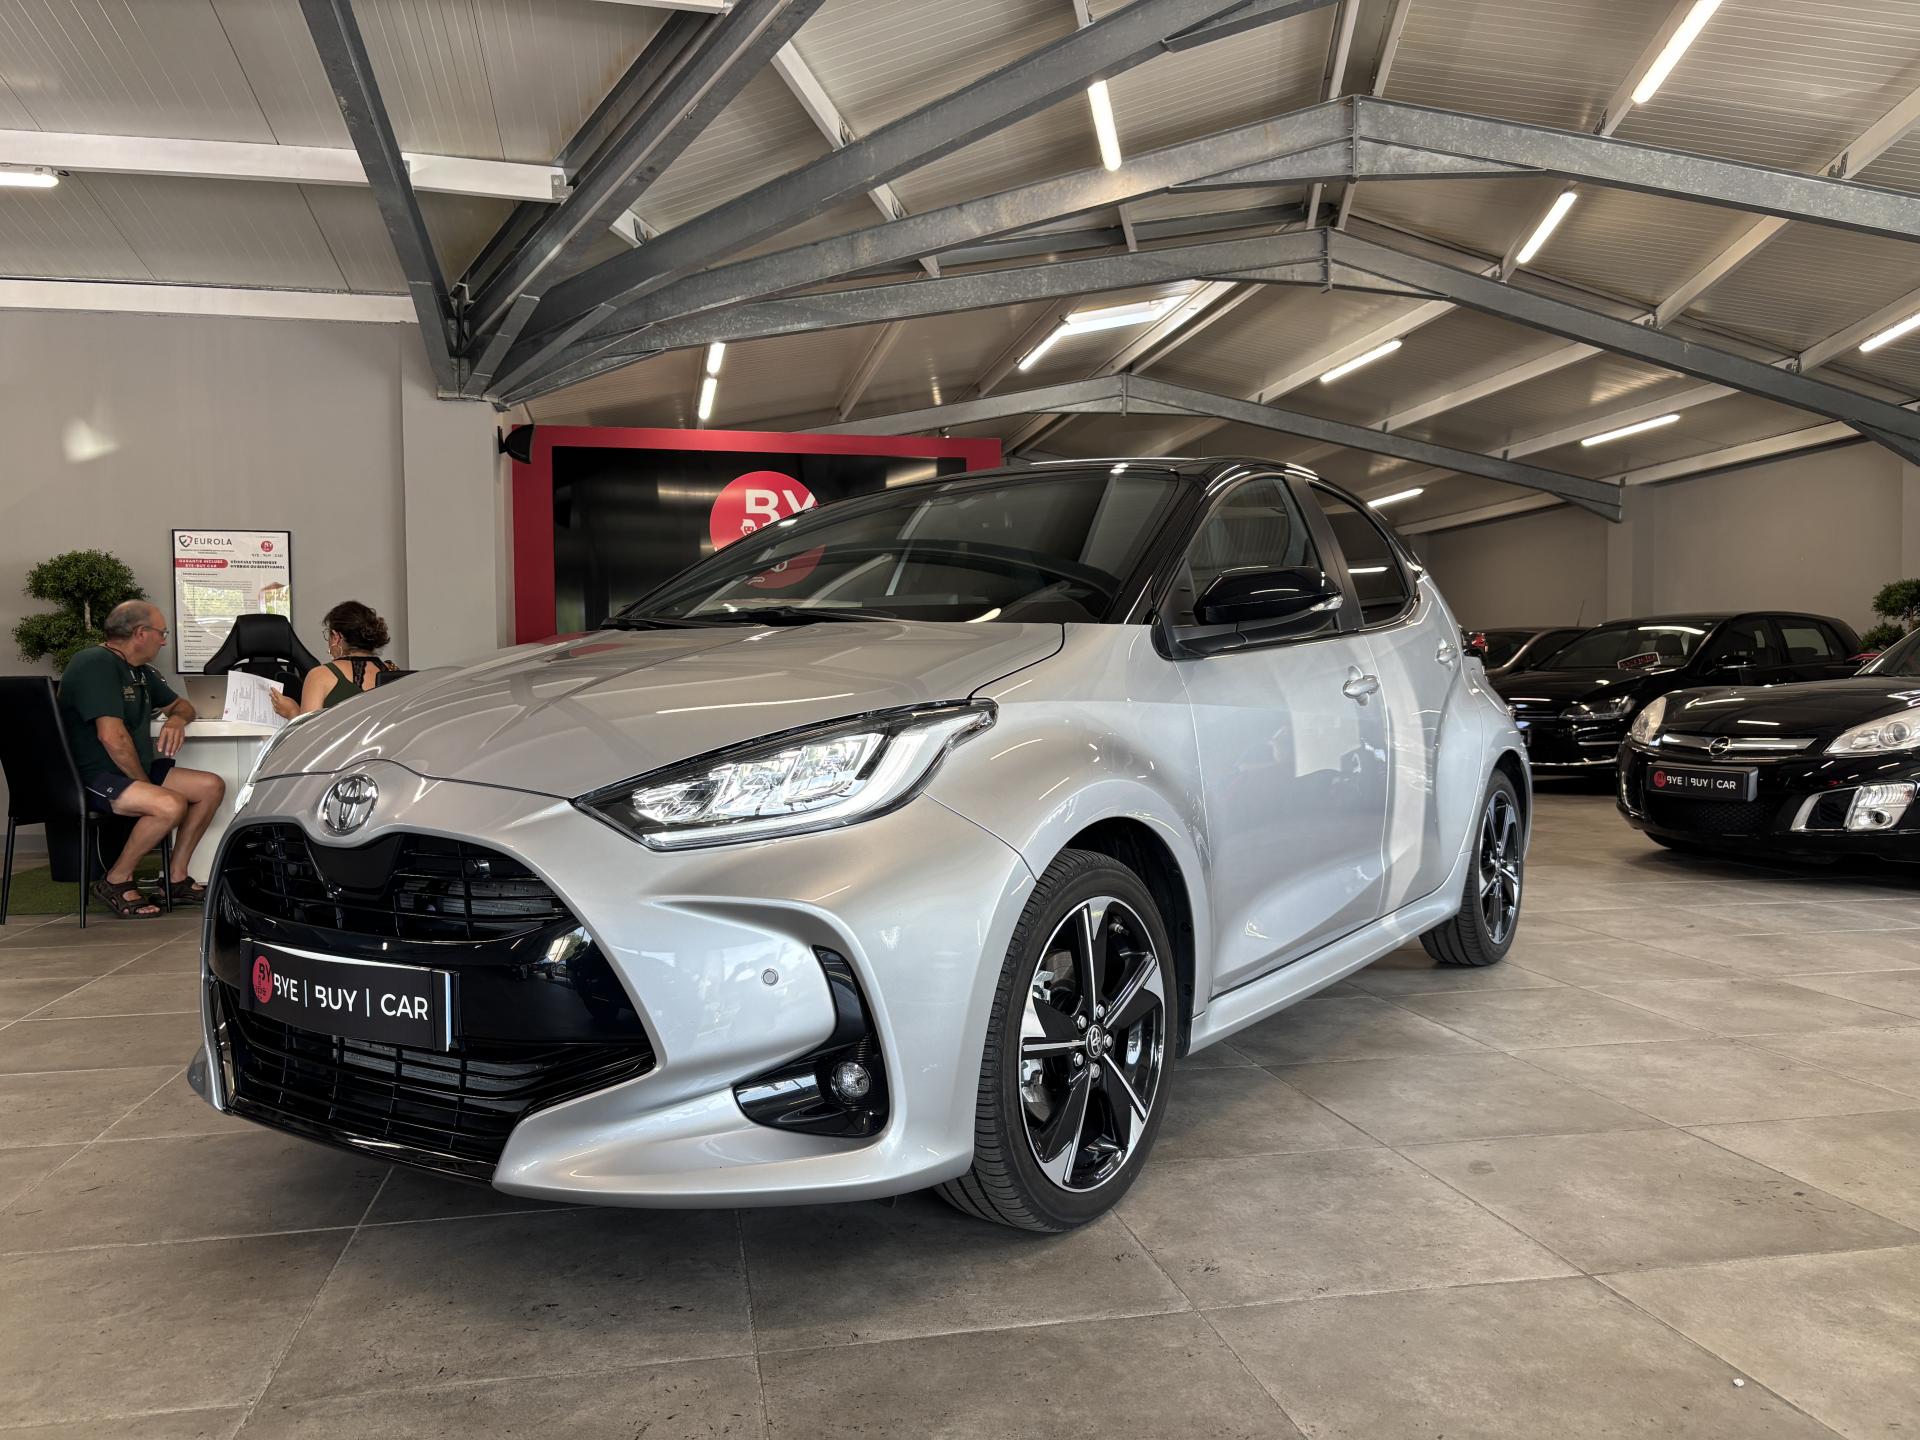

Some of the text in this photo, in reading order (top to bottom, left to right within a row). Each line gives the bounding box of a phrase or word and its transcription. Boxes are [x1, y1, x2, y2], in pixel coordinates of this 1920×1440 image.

[194, 537, 233, 546] EUROLA
[1666, 775, 1683, 785] BYE
[1690, 777, 1708, 787] BUY
[1716, 780, 1736, 790] CAR
[273, 972, 299, 1002] BYE
[314, 985, 358, 1012] BUY
[380, 993, 429, 1021] CAR
